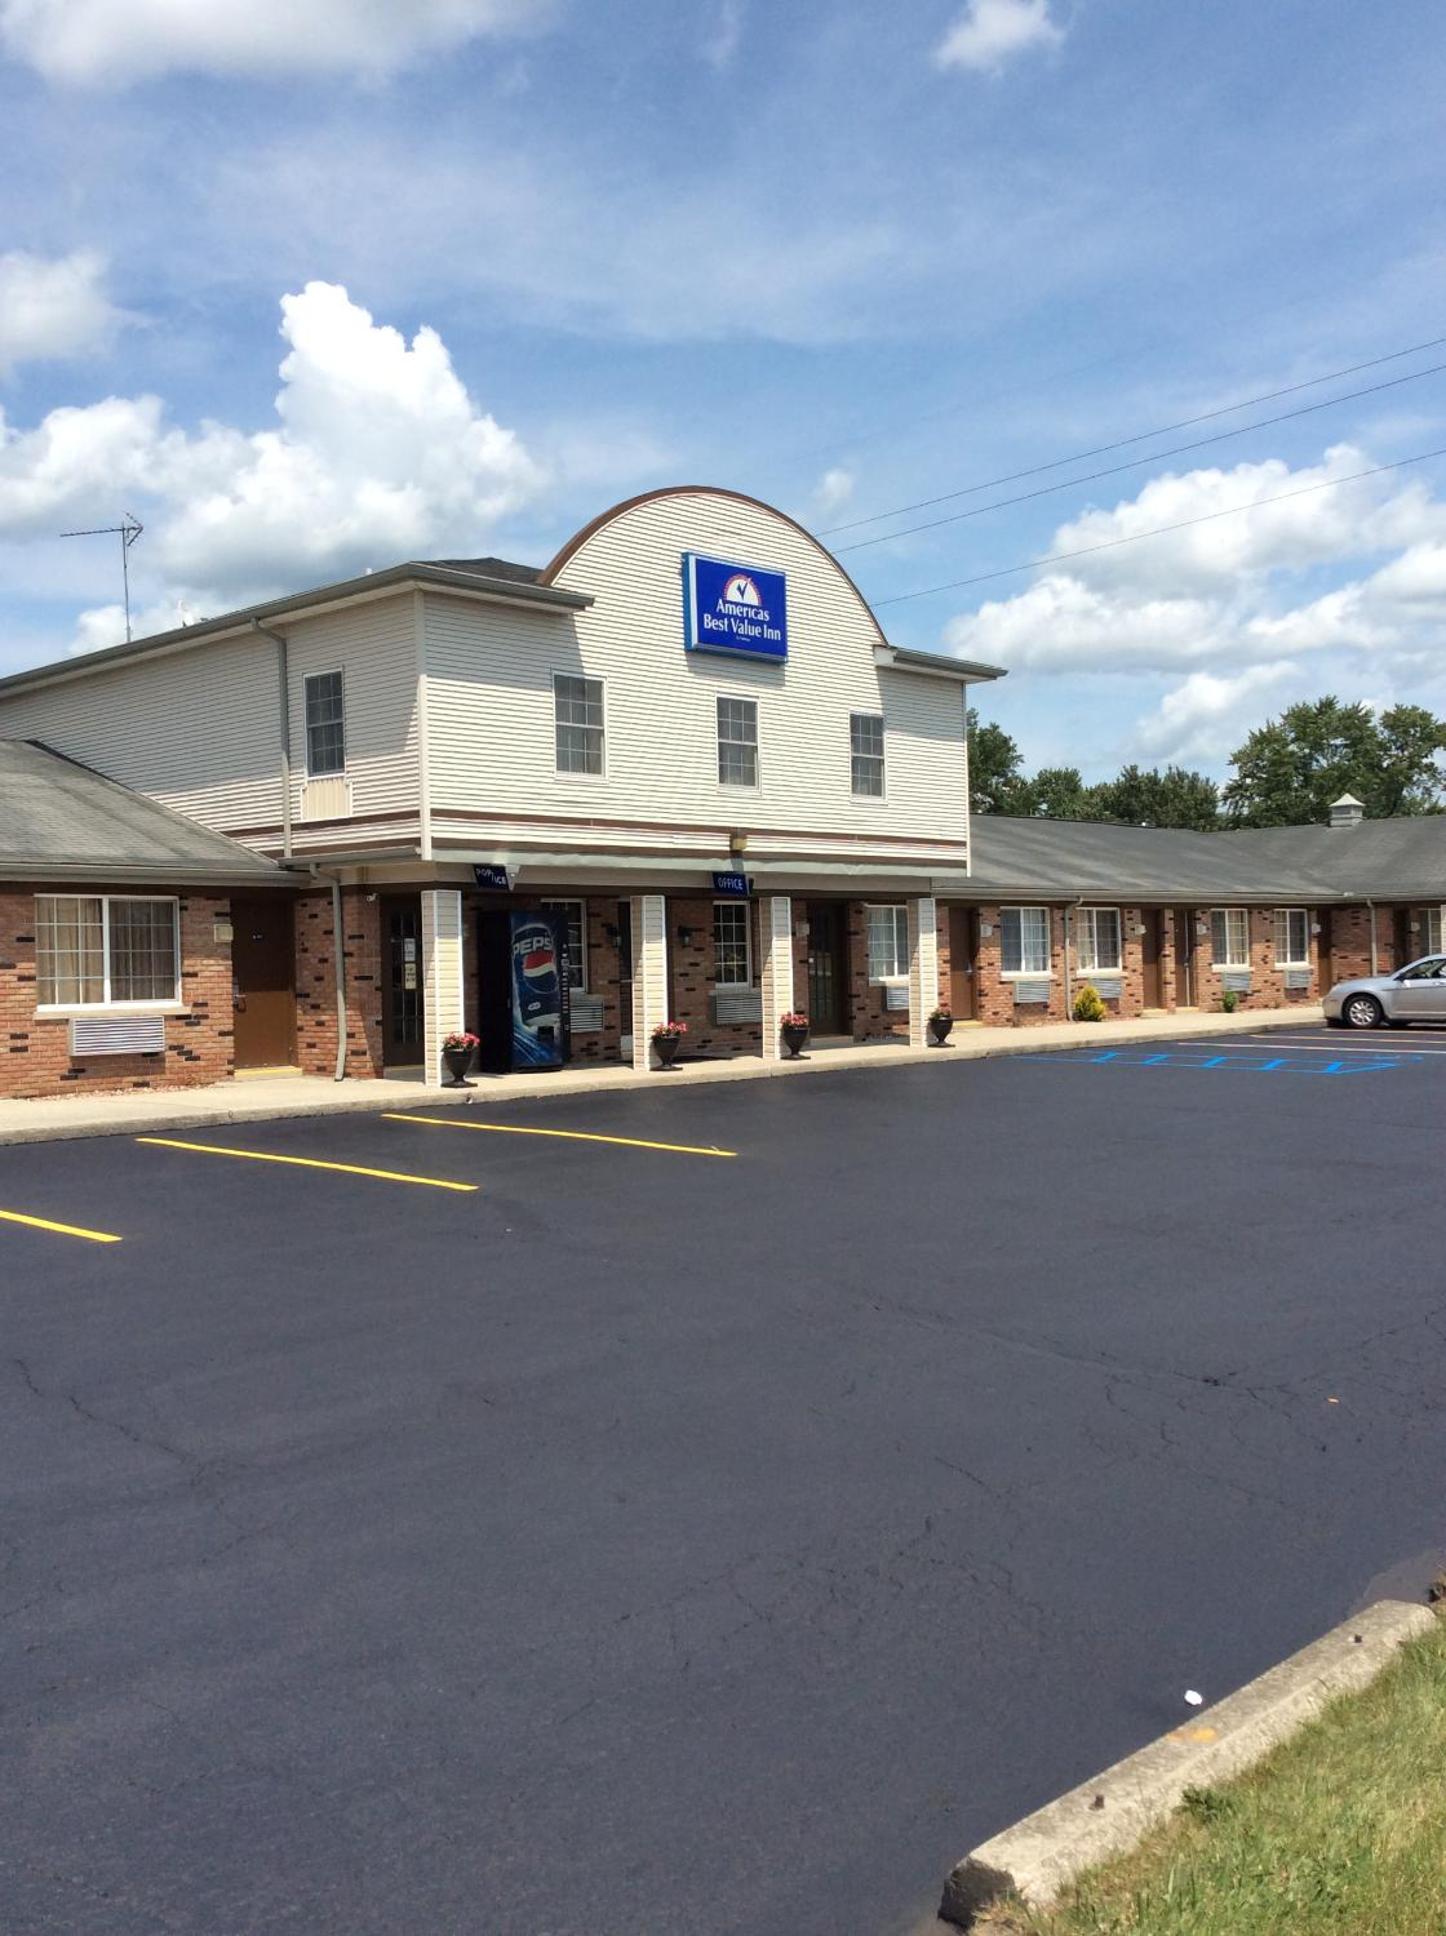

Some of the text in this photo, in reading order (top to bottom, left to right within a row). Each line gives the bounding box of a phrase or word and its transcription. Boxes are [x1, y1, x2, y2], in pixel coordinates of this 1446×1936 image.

[716, 598, 770, 622] Americas
[703, 613, 728, 632] Best
[730, 617, 762, 638] Value
[763, 624, 781, 641] Inn
[717, 876, 744, 890] OFFICE
